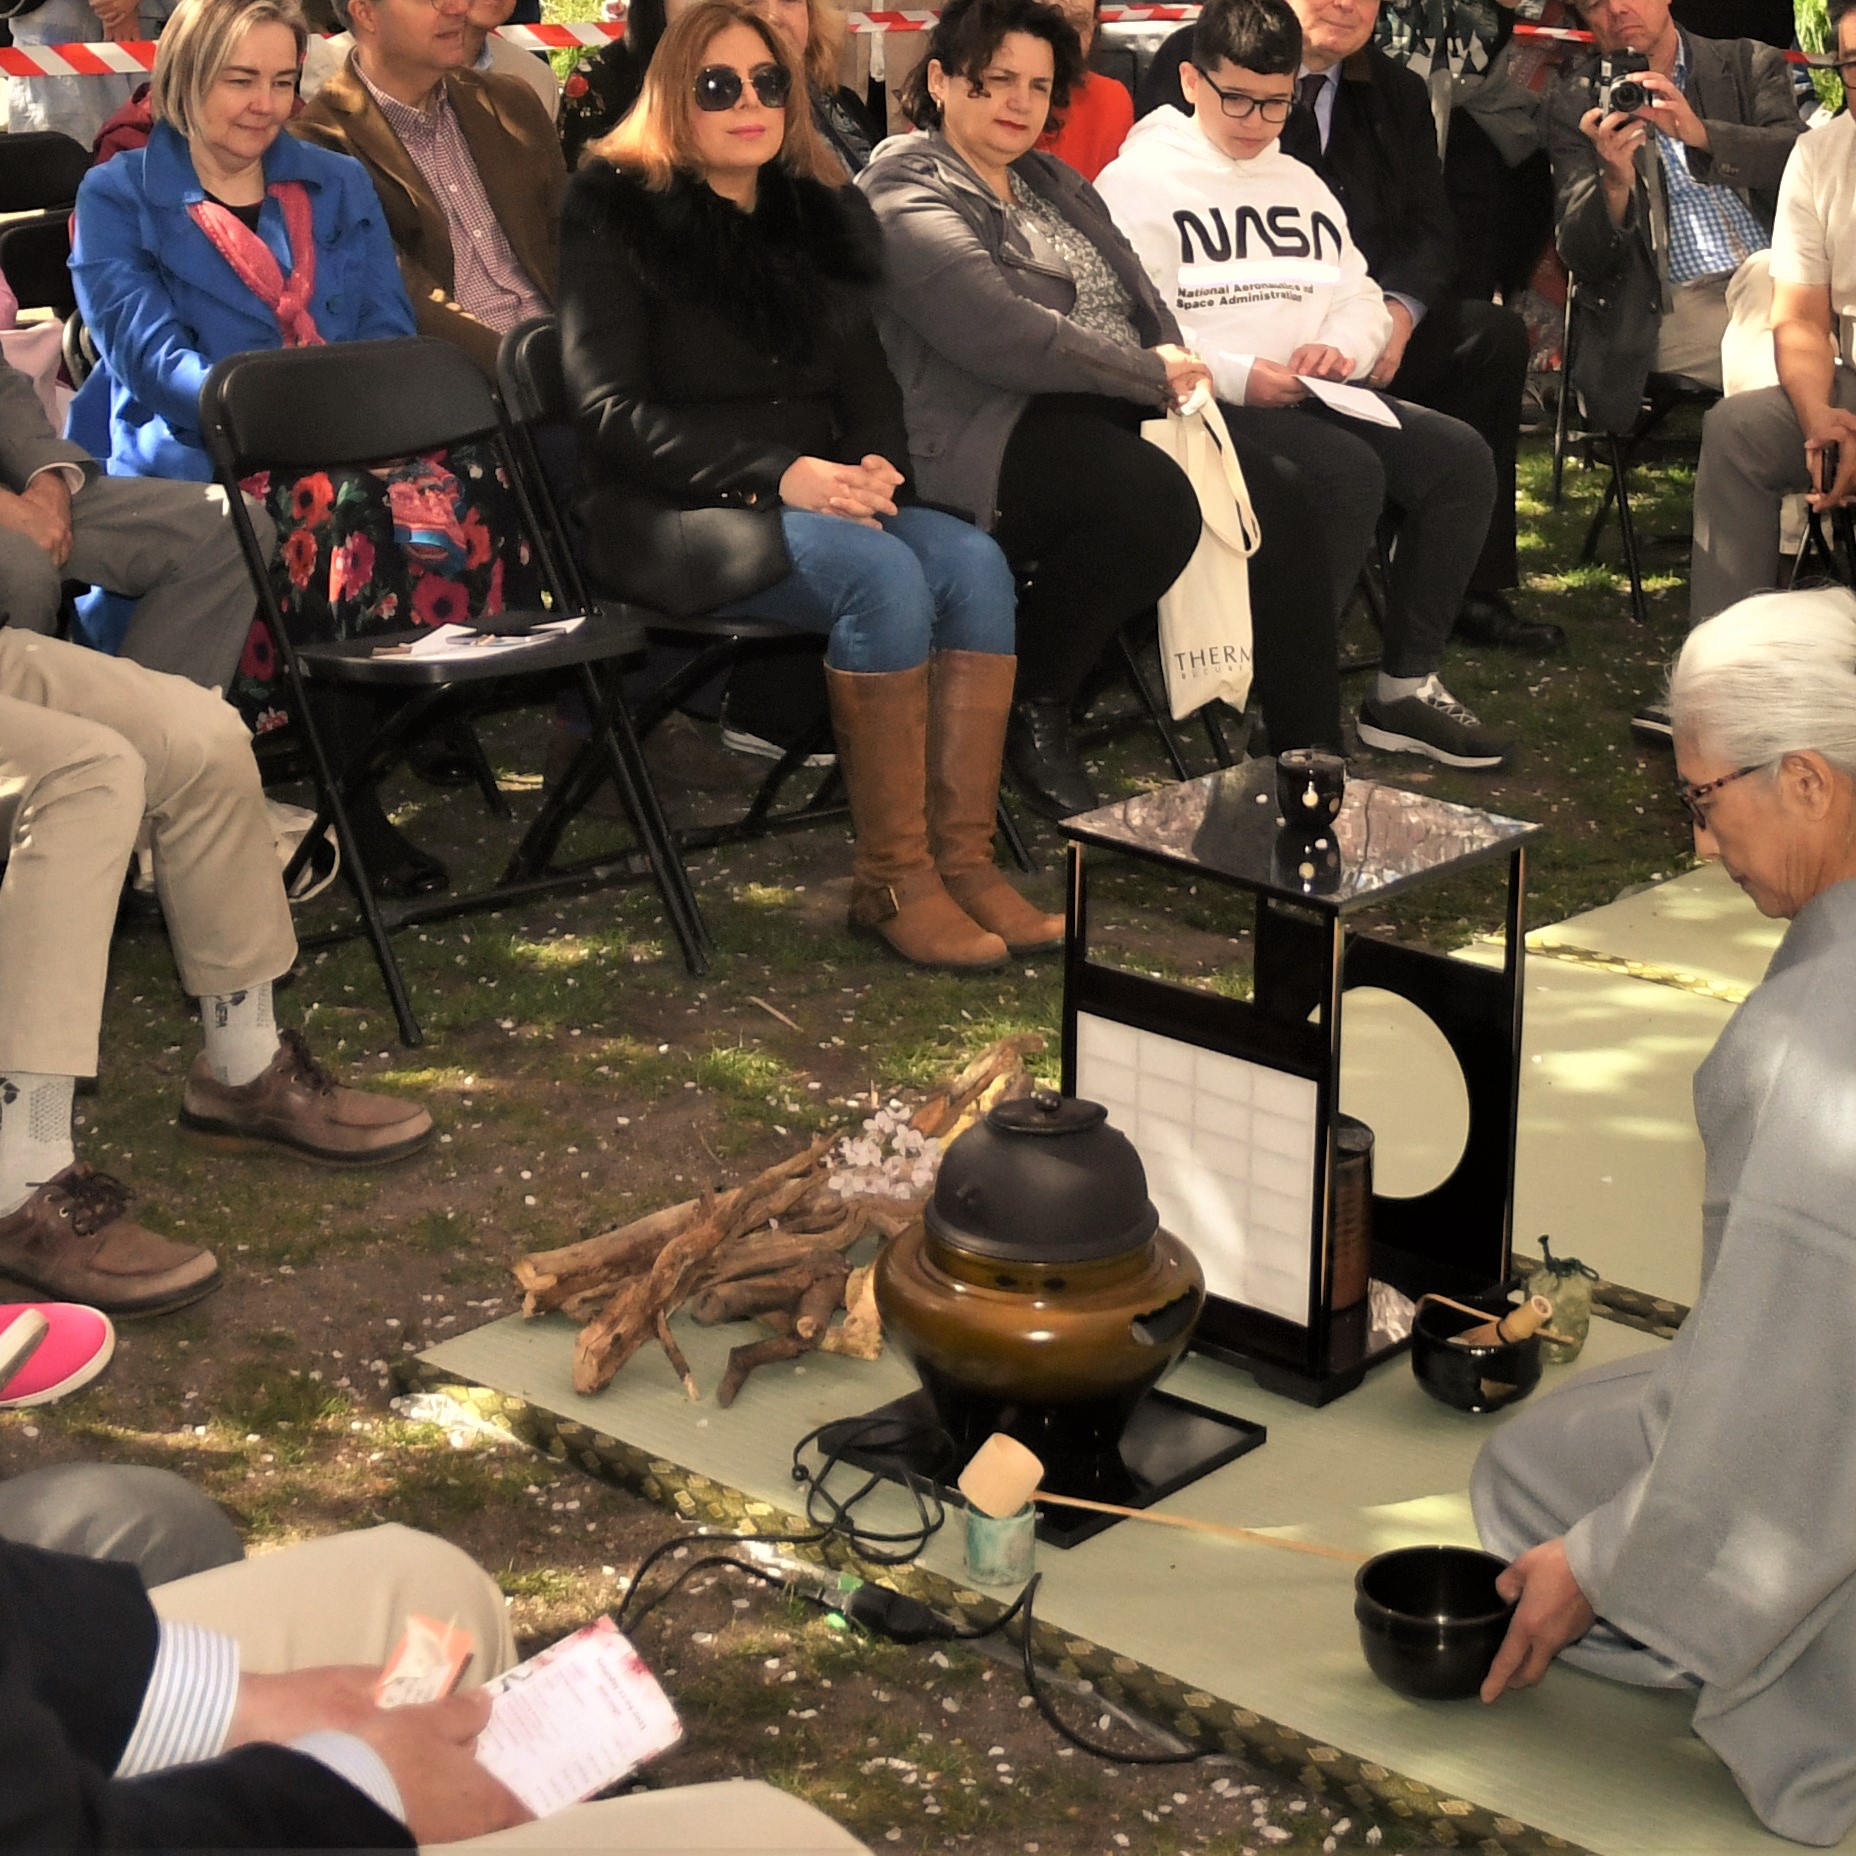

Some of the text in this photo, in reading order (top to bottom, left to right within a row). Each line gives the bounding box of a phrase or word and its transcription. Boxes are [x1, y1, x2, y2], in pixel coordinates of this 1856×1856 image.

[1172, 205, 1342, 263] NASA
[1178, 282, 1230, 298] National
[1176, 298, 1215, 310] Space
